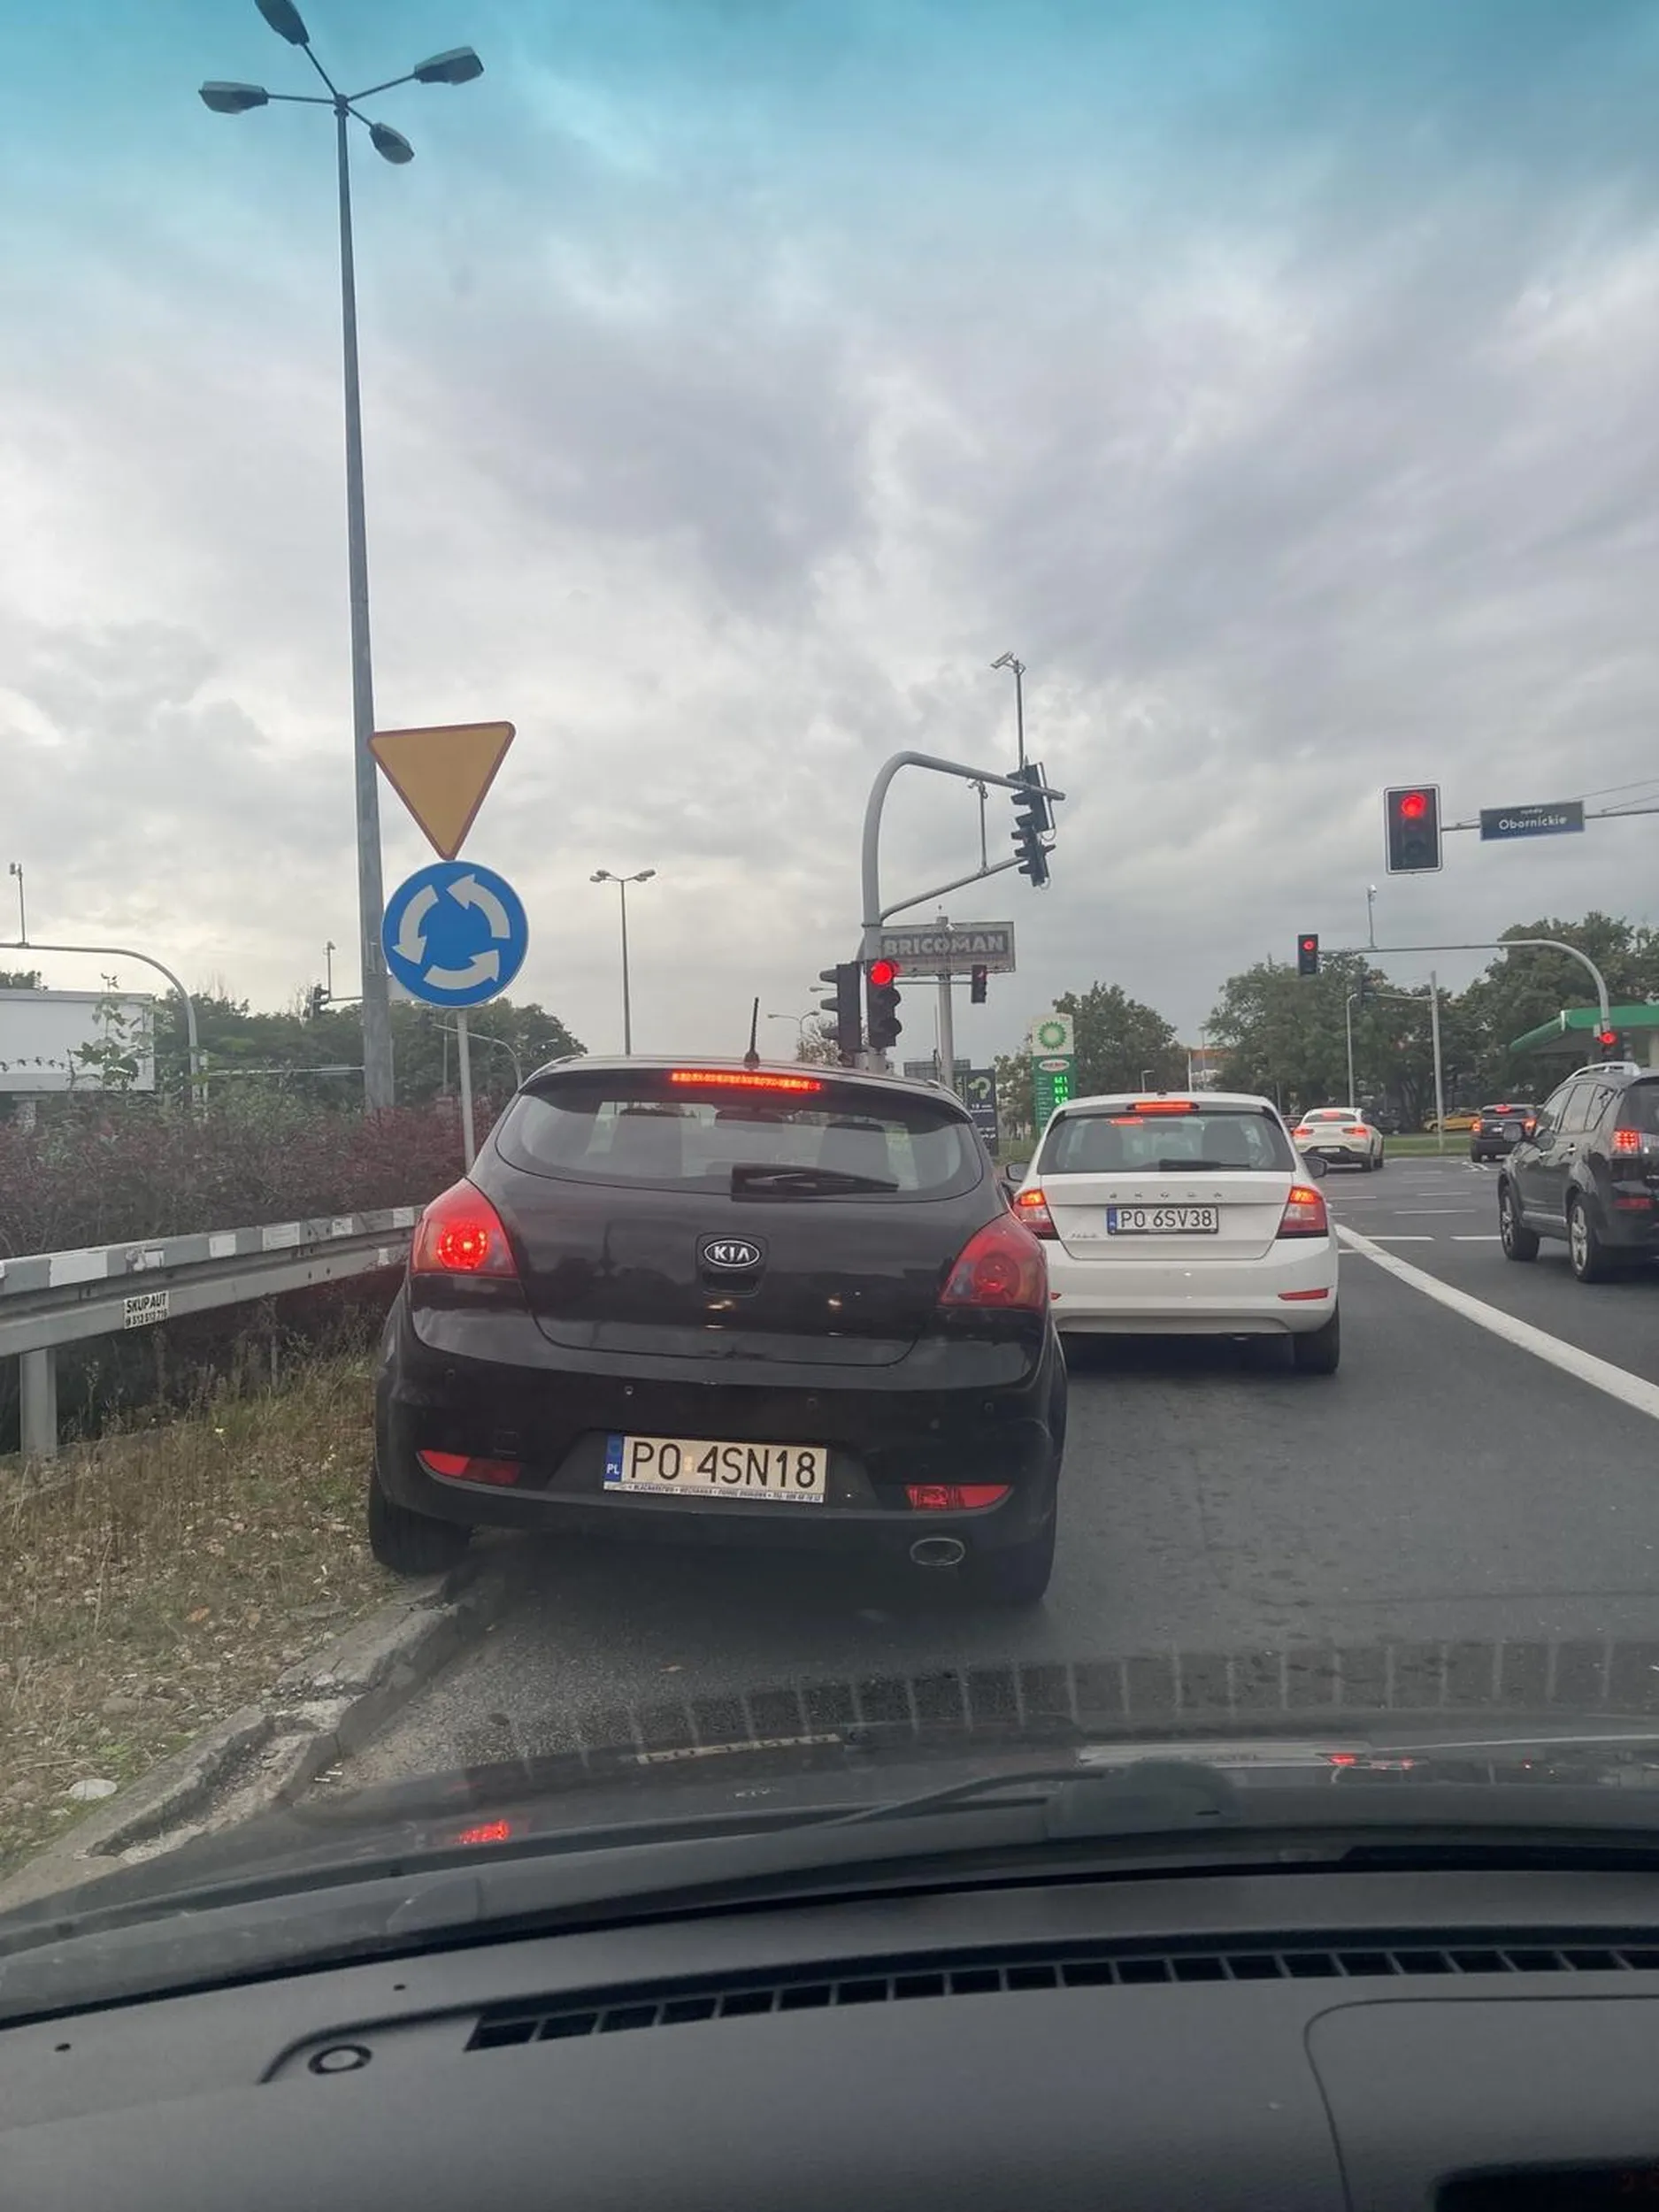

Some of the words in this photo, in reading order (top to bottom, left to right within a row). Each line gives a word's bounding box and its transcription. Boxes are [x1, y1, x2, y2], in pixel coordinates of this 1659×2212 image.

[1498, 814, 1568, 831] Obornickie
[885, 934, 1005, 956] BRICOMAN
[1120, 1210, 1146, 1228] PO
[1153, 1210, 1212, 1228] 6SV38
[714, 1246, 749, 1263] KIA
[127, 1295, 150, 1314] SKUP
[150, 1292, 166, 1309] AUT
[606, 1463, 619, 1474] PL
[631, 1440, 681, 1480] PO
[696, 1445, 816, 1489] 4SN18
